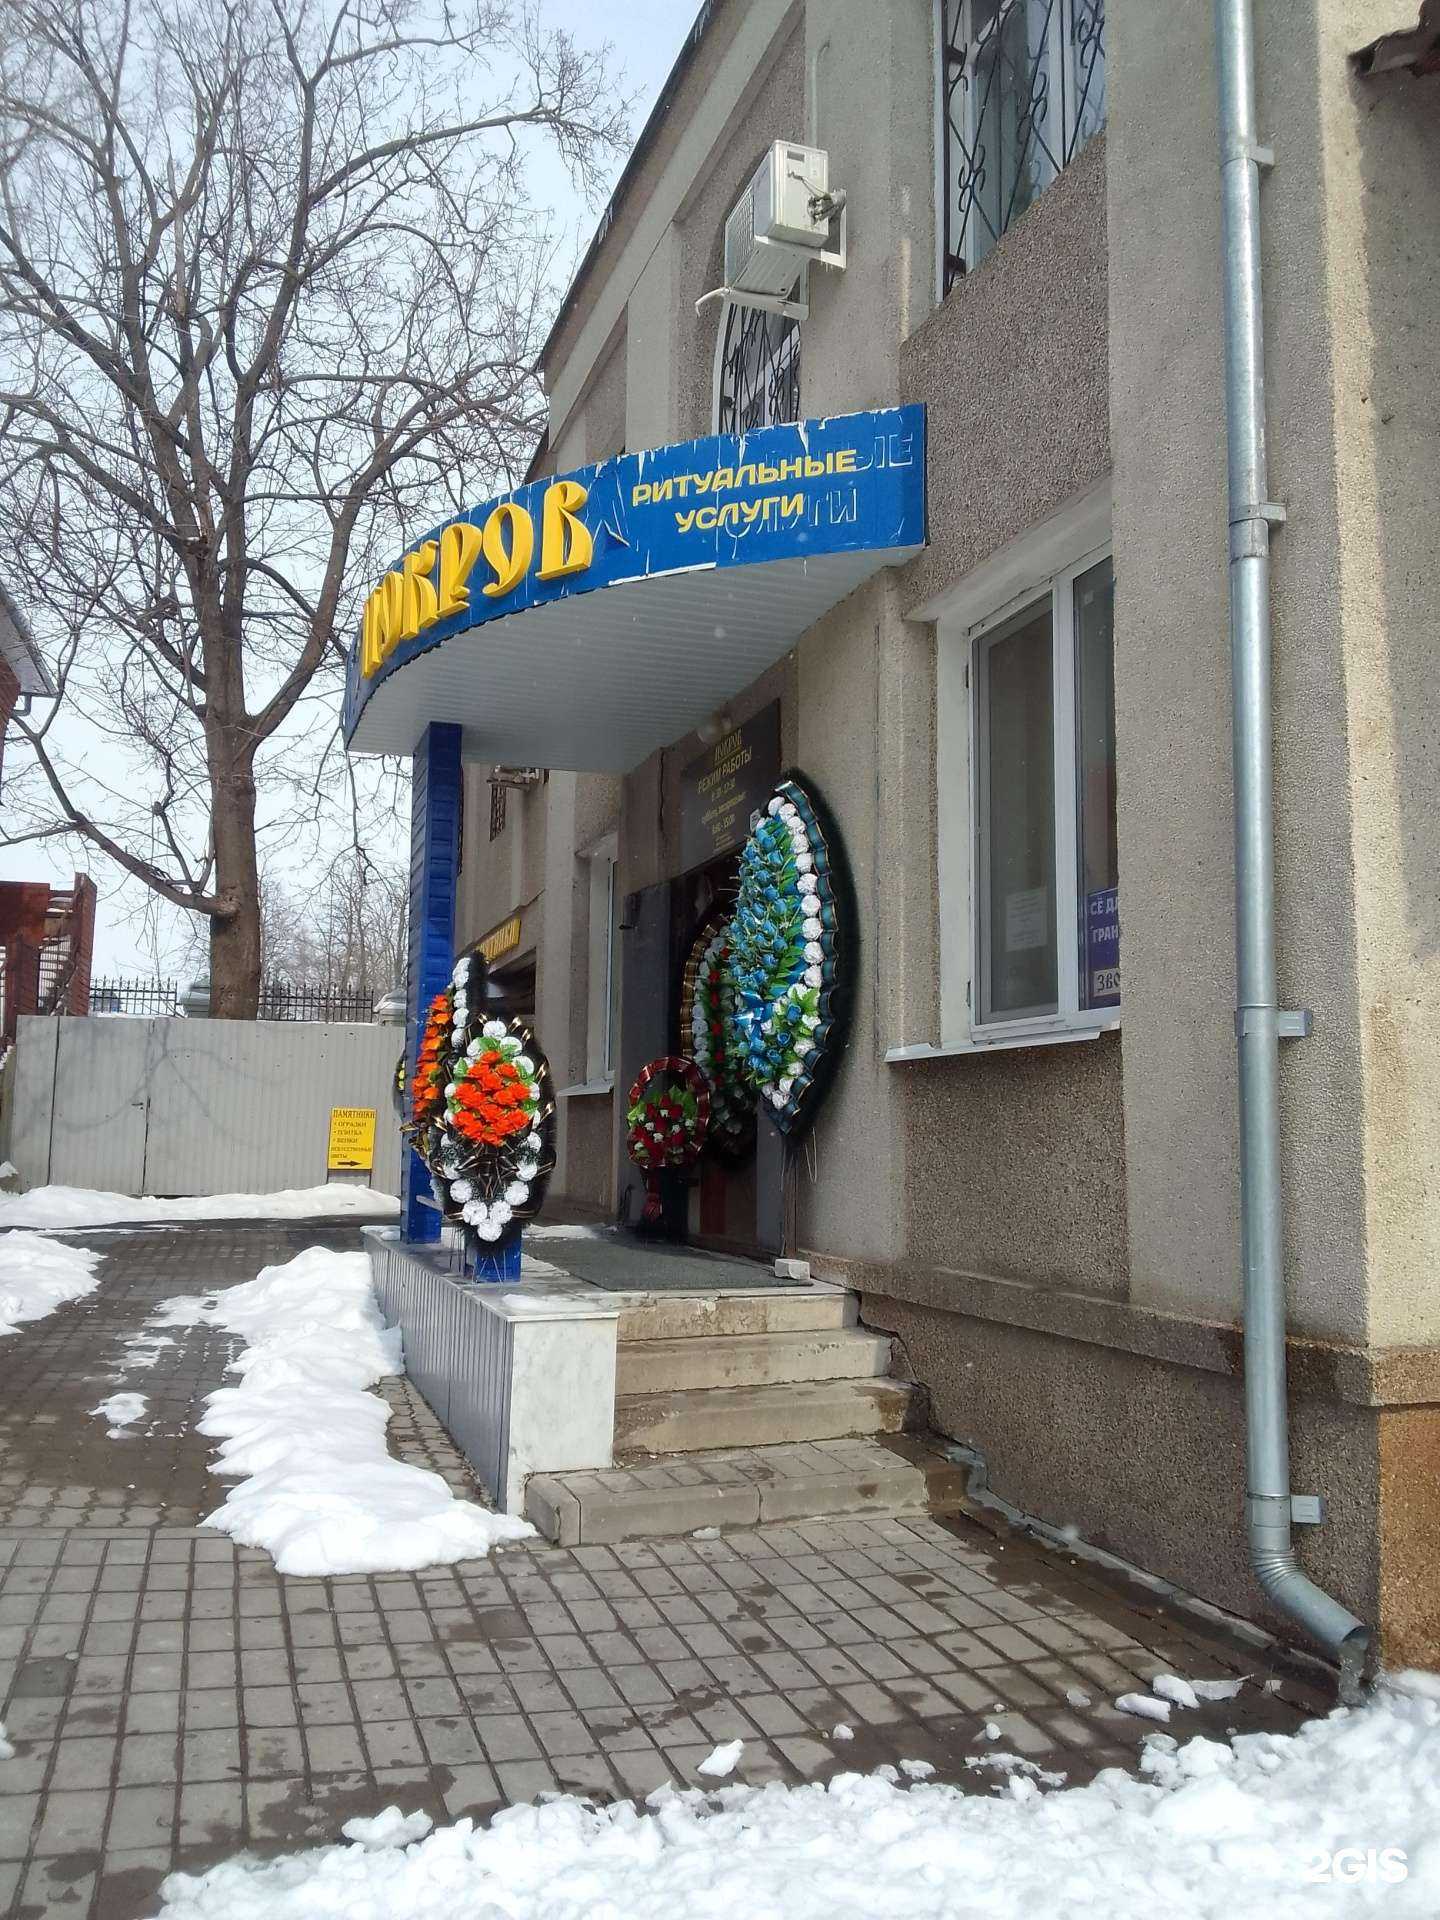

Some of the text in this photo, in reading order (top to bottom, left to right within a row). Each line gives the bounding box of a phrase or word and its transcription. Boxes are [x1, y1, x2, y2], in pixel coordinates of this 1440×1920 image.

[632, 449, 858, 507] РИТУАЛЬНЫЕ
[674, 493, 805, 533] УСЛУГИ
[361, 480, 594, 678] ПОКРОВ
[722, 745, 753, 776] РАБОТЫ
[333, 1109, 375, 1119] ПАМЯТНИКИ
